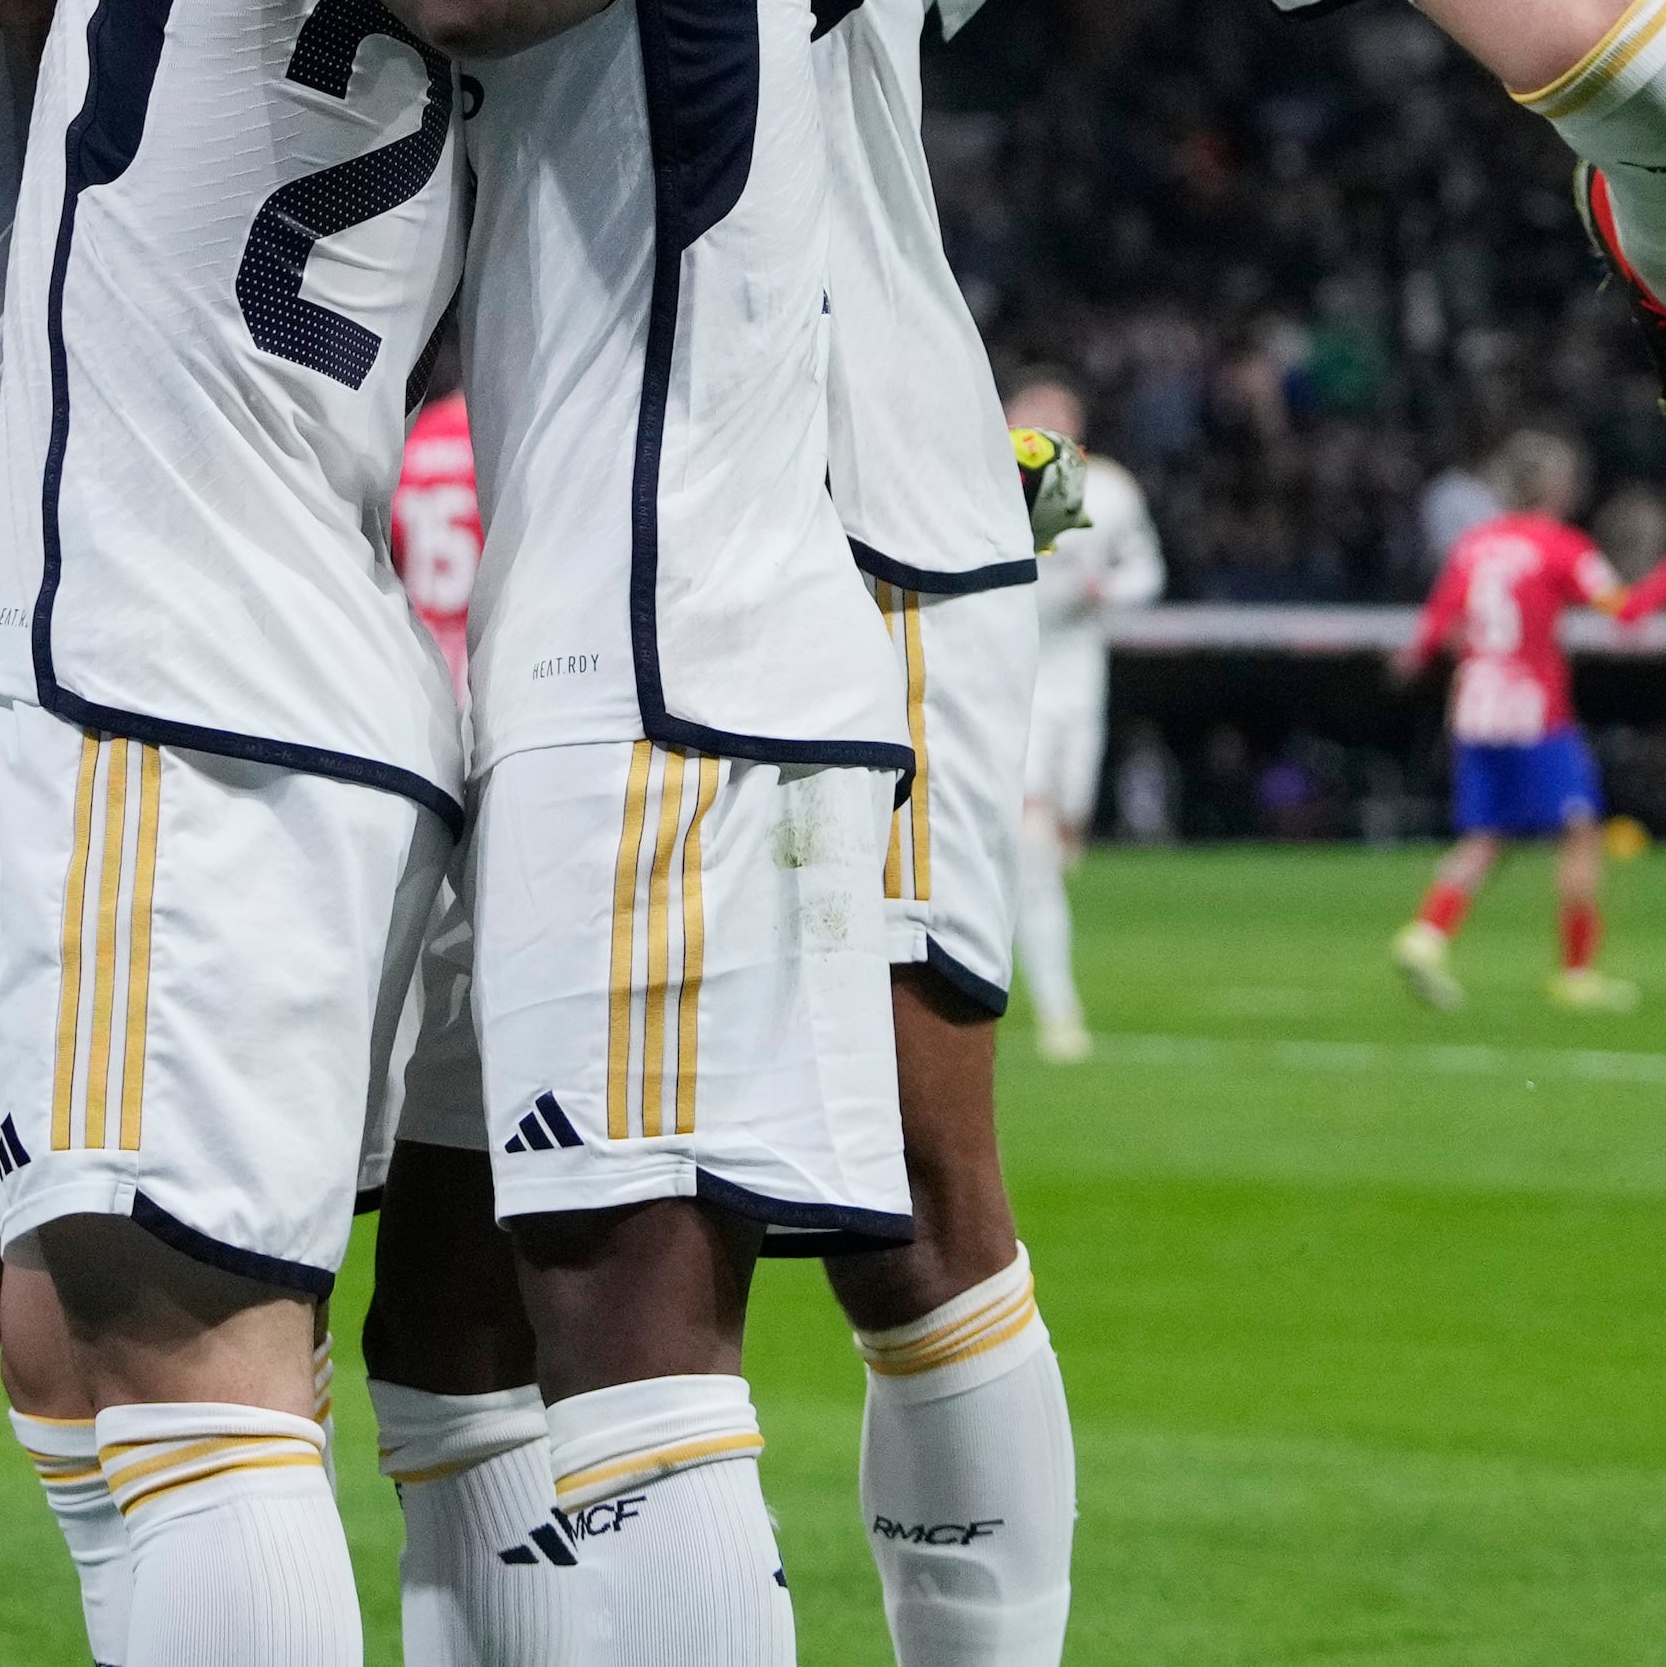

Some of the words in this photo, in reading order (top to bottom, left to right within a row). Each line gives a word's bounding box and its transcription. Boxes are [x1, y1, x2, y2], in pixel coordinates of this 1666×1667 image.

[532, 653, 599, 681] HEAT.RDY
[571, 1495, 647, 1542] MCF
[873, 1514, 1005, 1546] RMCF
